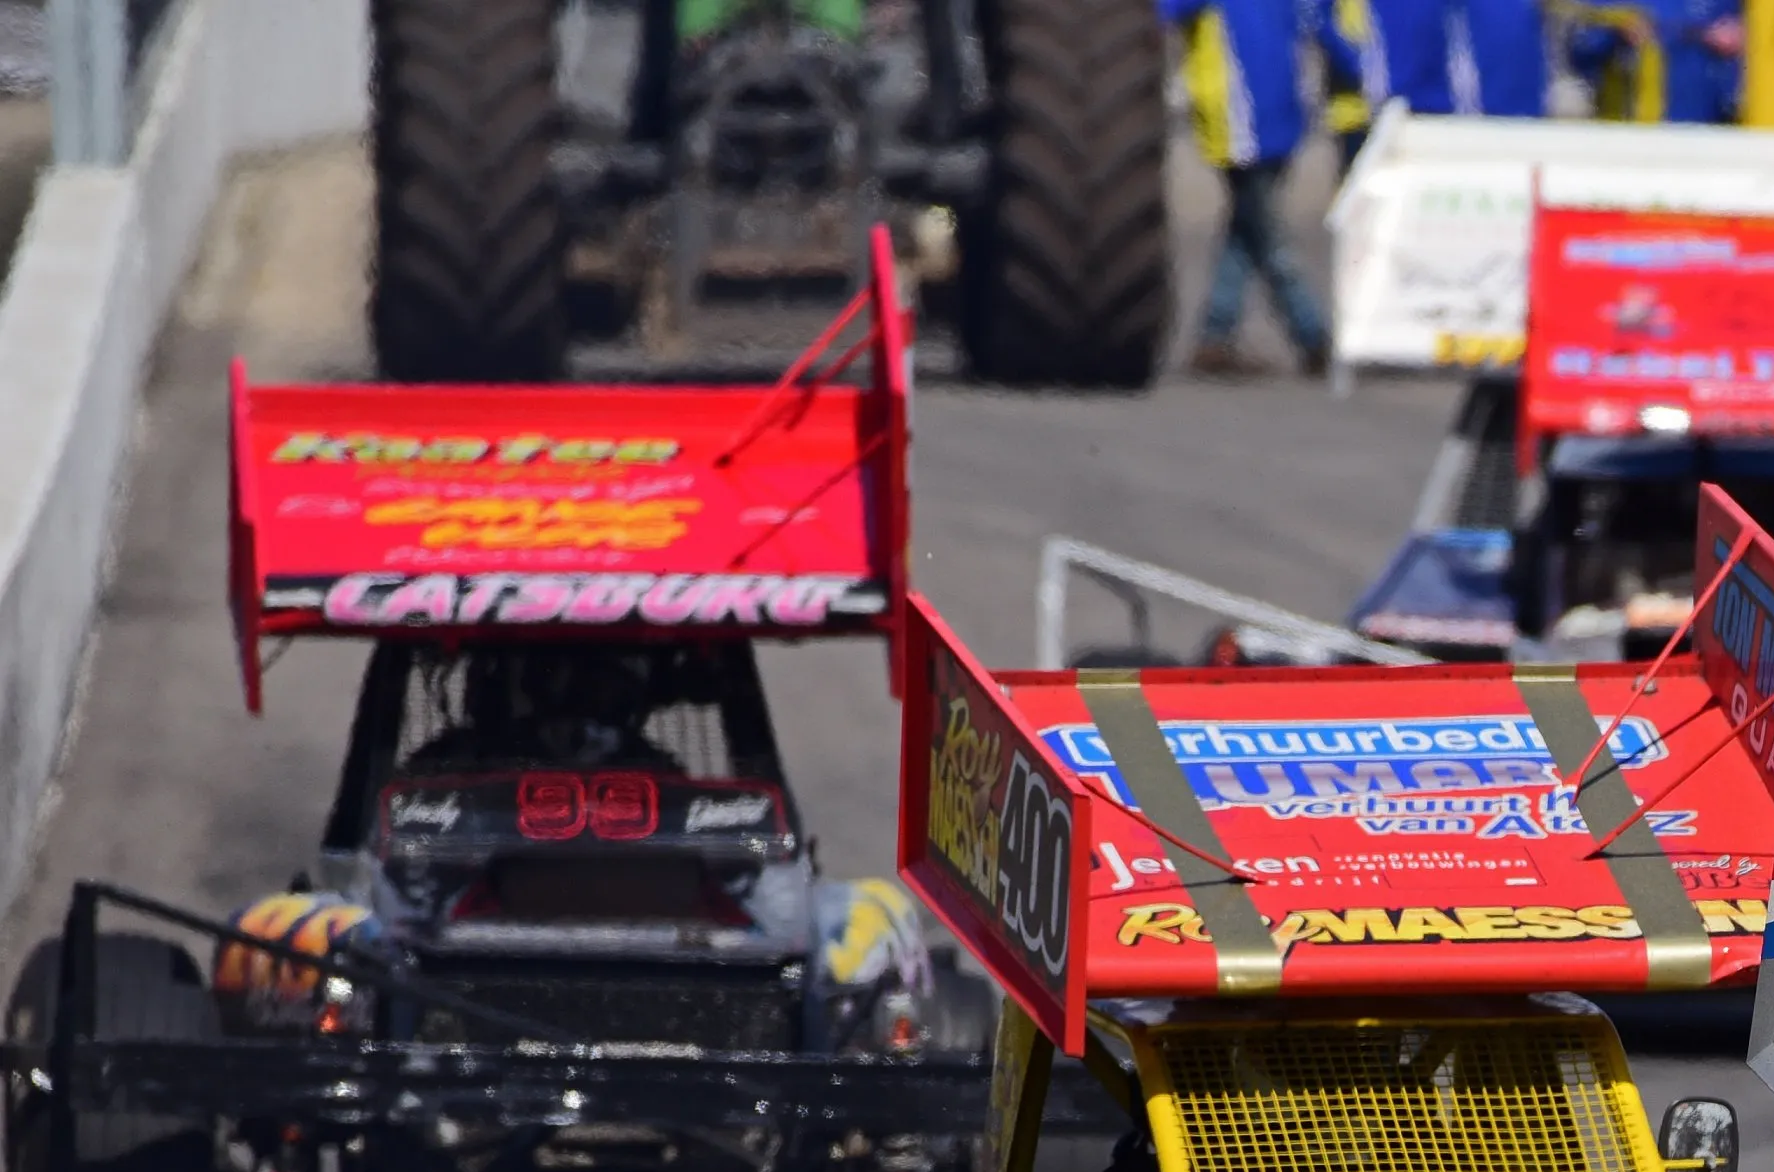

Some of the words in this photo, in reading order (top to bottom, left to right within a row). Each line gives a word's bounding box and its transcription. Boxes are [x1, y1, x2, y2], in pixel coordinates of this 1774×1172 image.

[940, 697, 1001, 810] Roy
[1000, 750, 1075, 978] 400
[1485, 815, 1540, 836] A
[1305, 900, 1767, 948] MAESSN
